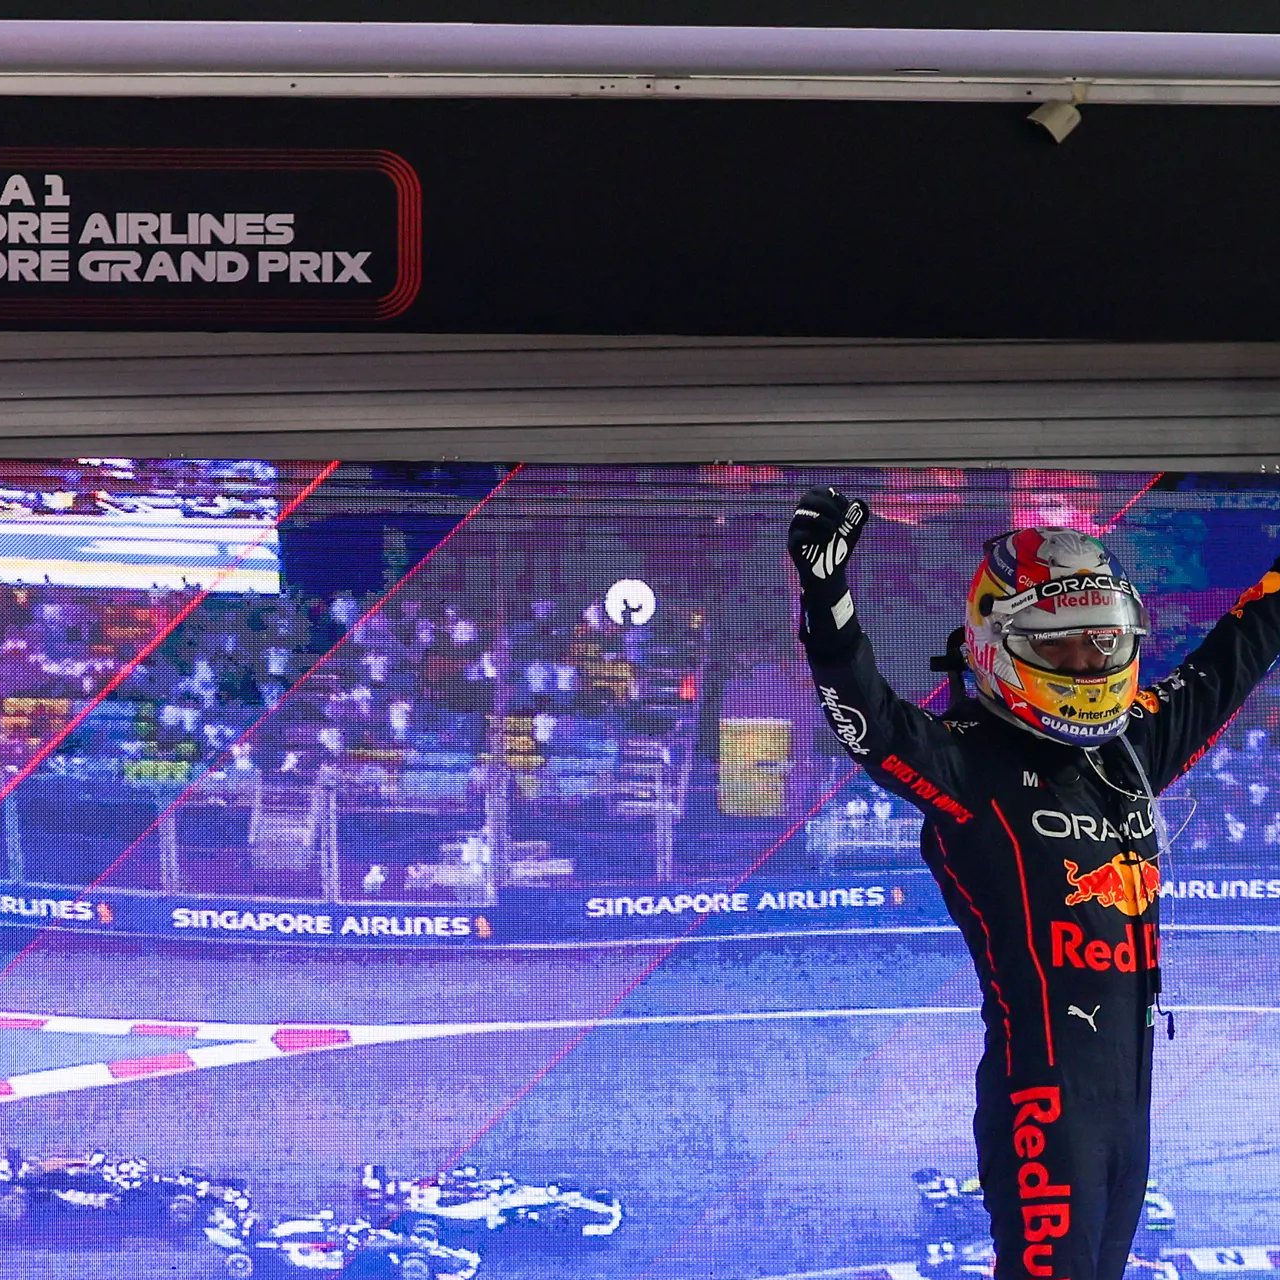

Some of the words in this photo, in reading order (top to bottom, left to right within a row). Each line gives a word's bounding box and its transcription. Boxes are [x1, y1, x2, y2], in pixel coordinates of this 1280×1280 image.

[45, 174, 70, 206] 1
[79, 213, 294, 245] AIRLINES
[79, 251, 249, 283] GRAND
[258, 252, 372, 283] PRIX
[1041, 576, 1131, 597] ORACLE
[1057, 592, 1089, 608] Red
[1091, 590, 1118, 606] Bull
[586, 892, 750, 919] SINGAPORE
[757, 885, 885, 910] AIRLINES
[172, 907, 332, 936] SINGAPORE
[341, 915, 471, 937] AIRLINES
[1051, 920, 1137, 973] Red
[1009, 1085, 1071, 1199] Red
